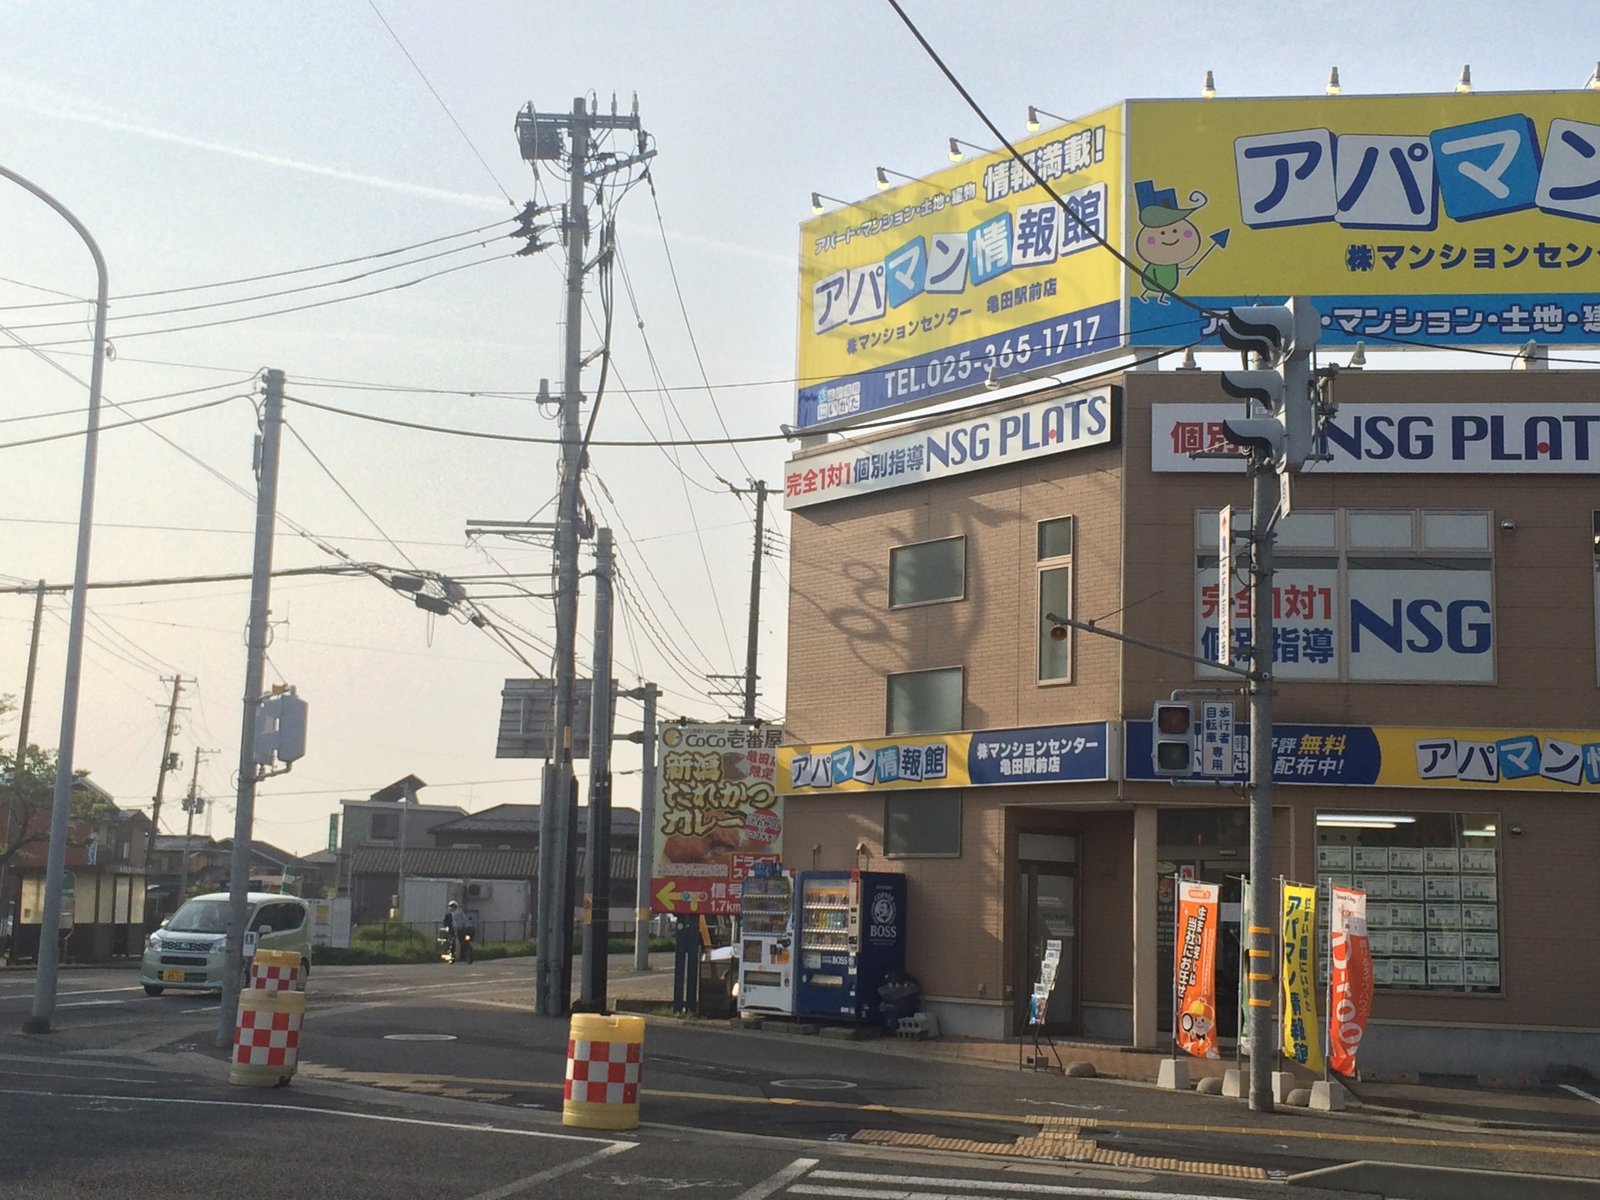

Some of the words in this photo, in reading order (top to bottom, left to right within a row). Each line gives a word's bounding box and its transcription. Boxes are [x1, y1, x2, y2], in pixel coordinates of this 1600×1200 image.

[814, 188, 1102, 326] アパマン情報館
[1345, 241, 1600, 273] ㈱マンションセン
[986, 277, 1058, 314] 亀田駅前店
[926, 422, 991, 473] NSG
[1319, 415, 1434, 461] NSG
[1350, 599, 1492, 655] NSG
[1297, 733, 1347, 756] 無料
[791, 745, 946, 783] アパマン情報館
[999, 756, 1060, 776] 亀田駅前店
[869, 924, 897, 938] BOSS
